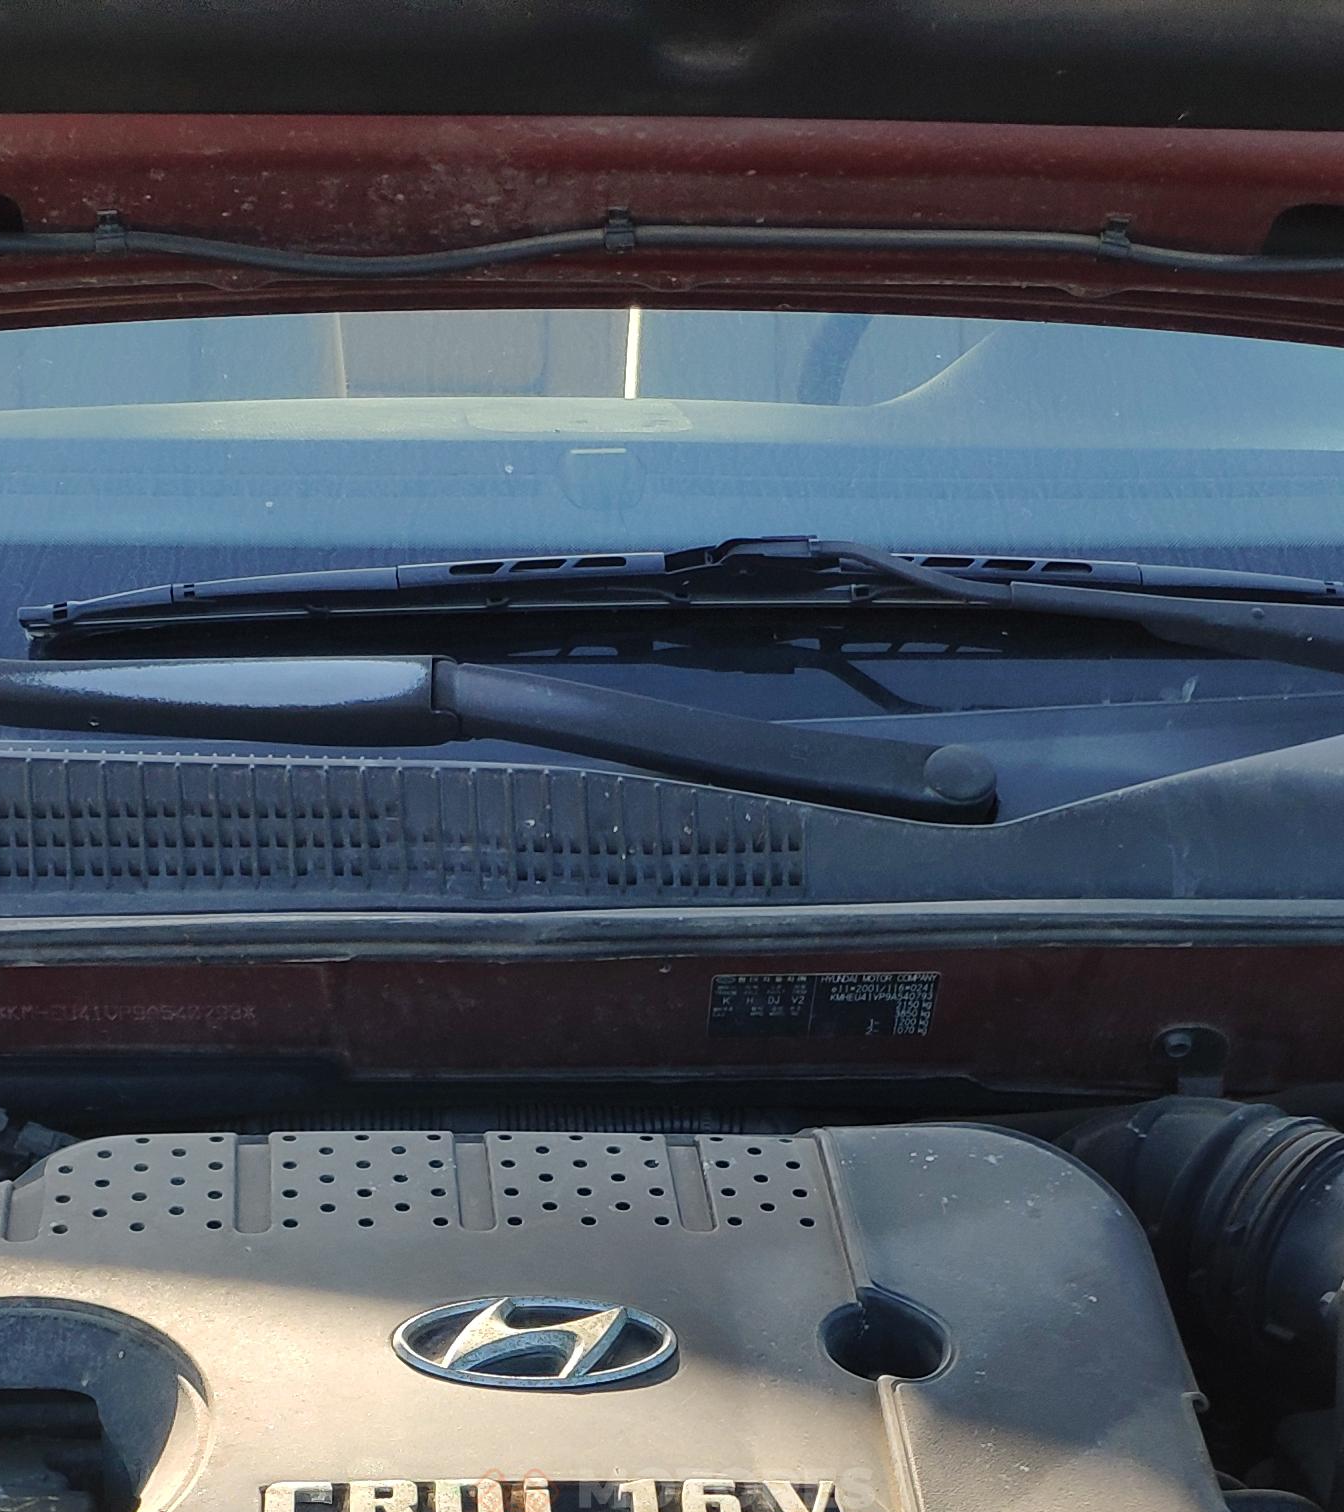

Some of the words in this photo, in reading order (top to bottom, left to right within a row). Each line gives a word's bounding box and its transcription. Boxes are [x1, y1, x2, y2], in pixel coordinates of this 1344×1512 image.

[820, 975, 857, 983] HYUNDAI
[862, 974, 893, 983] MOTOR
[896, 974, 937, 983] COMPANY
